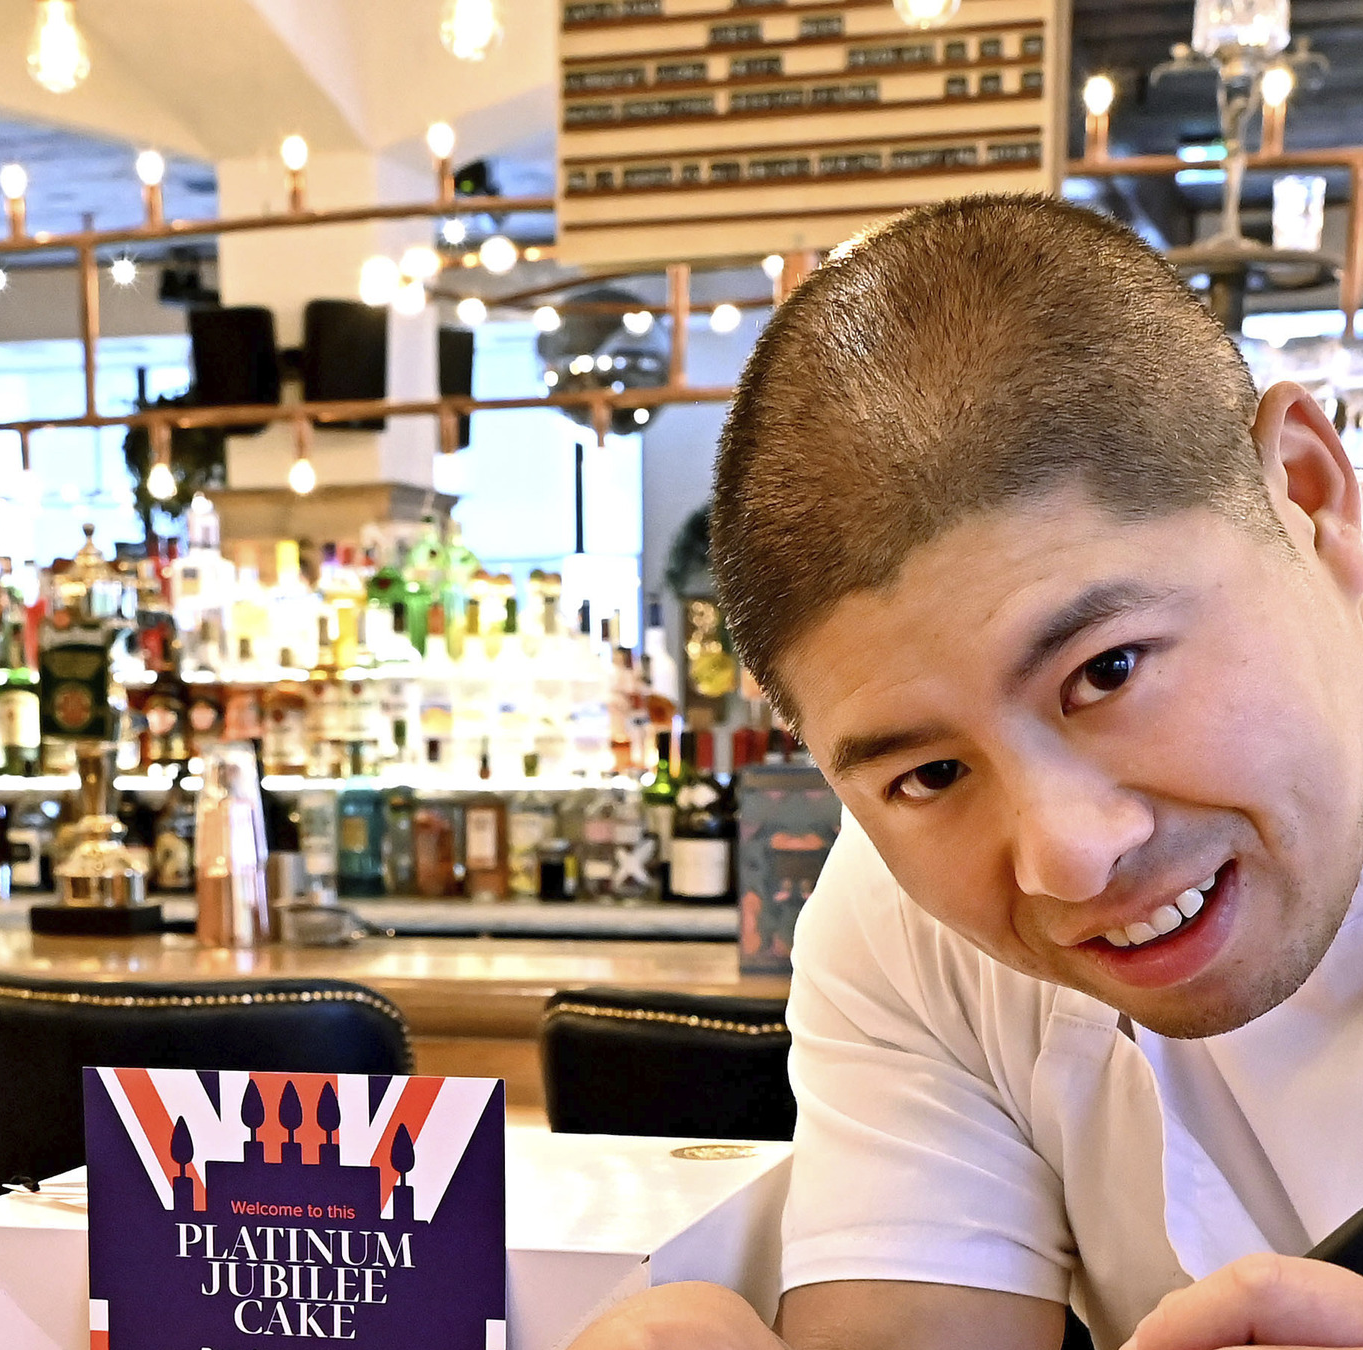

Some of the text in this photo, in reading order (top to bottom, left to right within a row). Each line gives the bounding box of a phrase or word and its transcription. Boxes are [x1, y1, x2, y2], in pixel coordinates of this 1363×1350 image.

[230, 1199, 356, 1219] Welcome to this
[174, 1222, 415, 1268] PLATINUM
[201, 1260, 387, 1304] JUBILEE
[233, 1298, 356, 1340] CAKE
